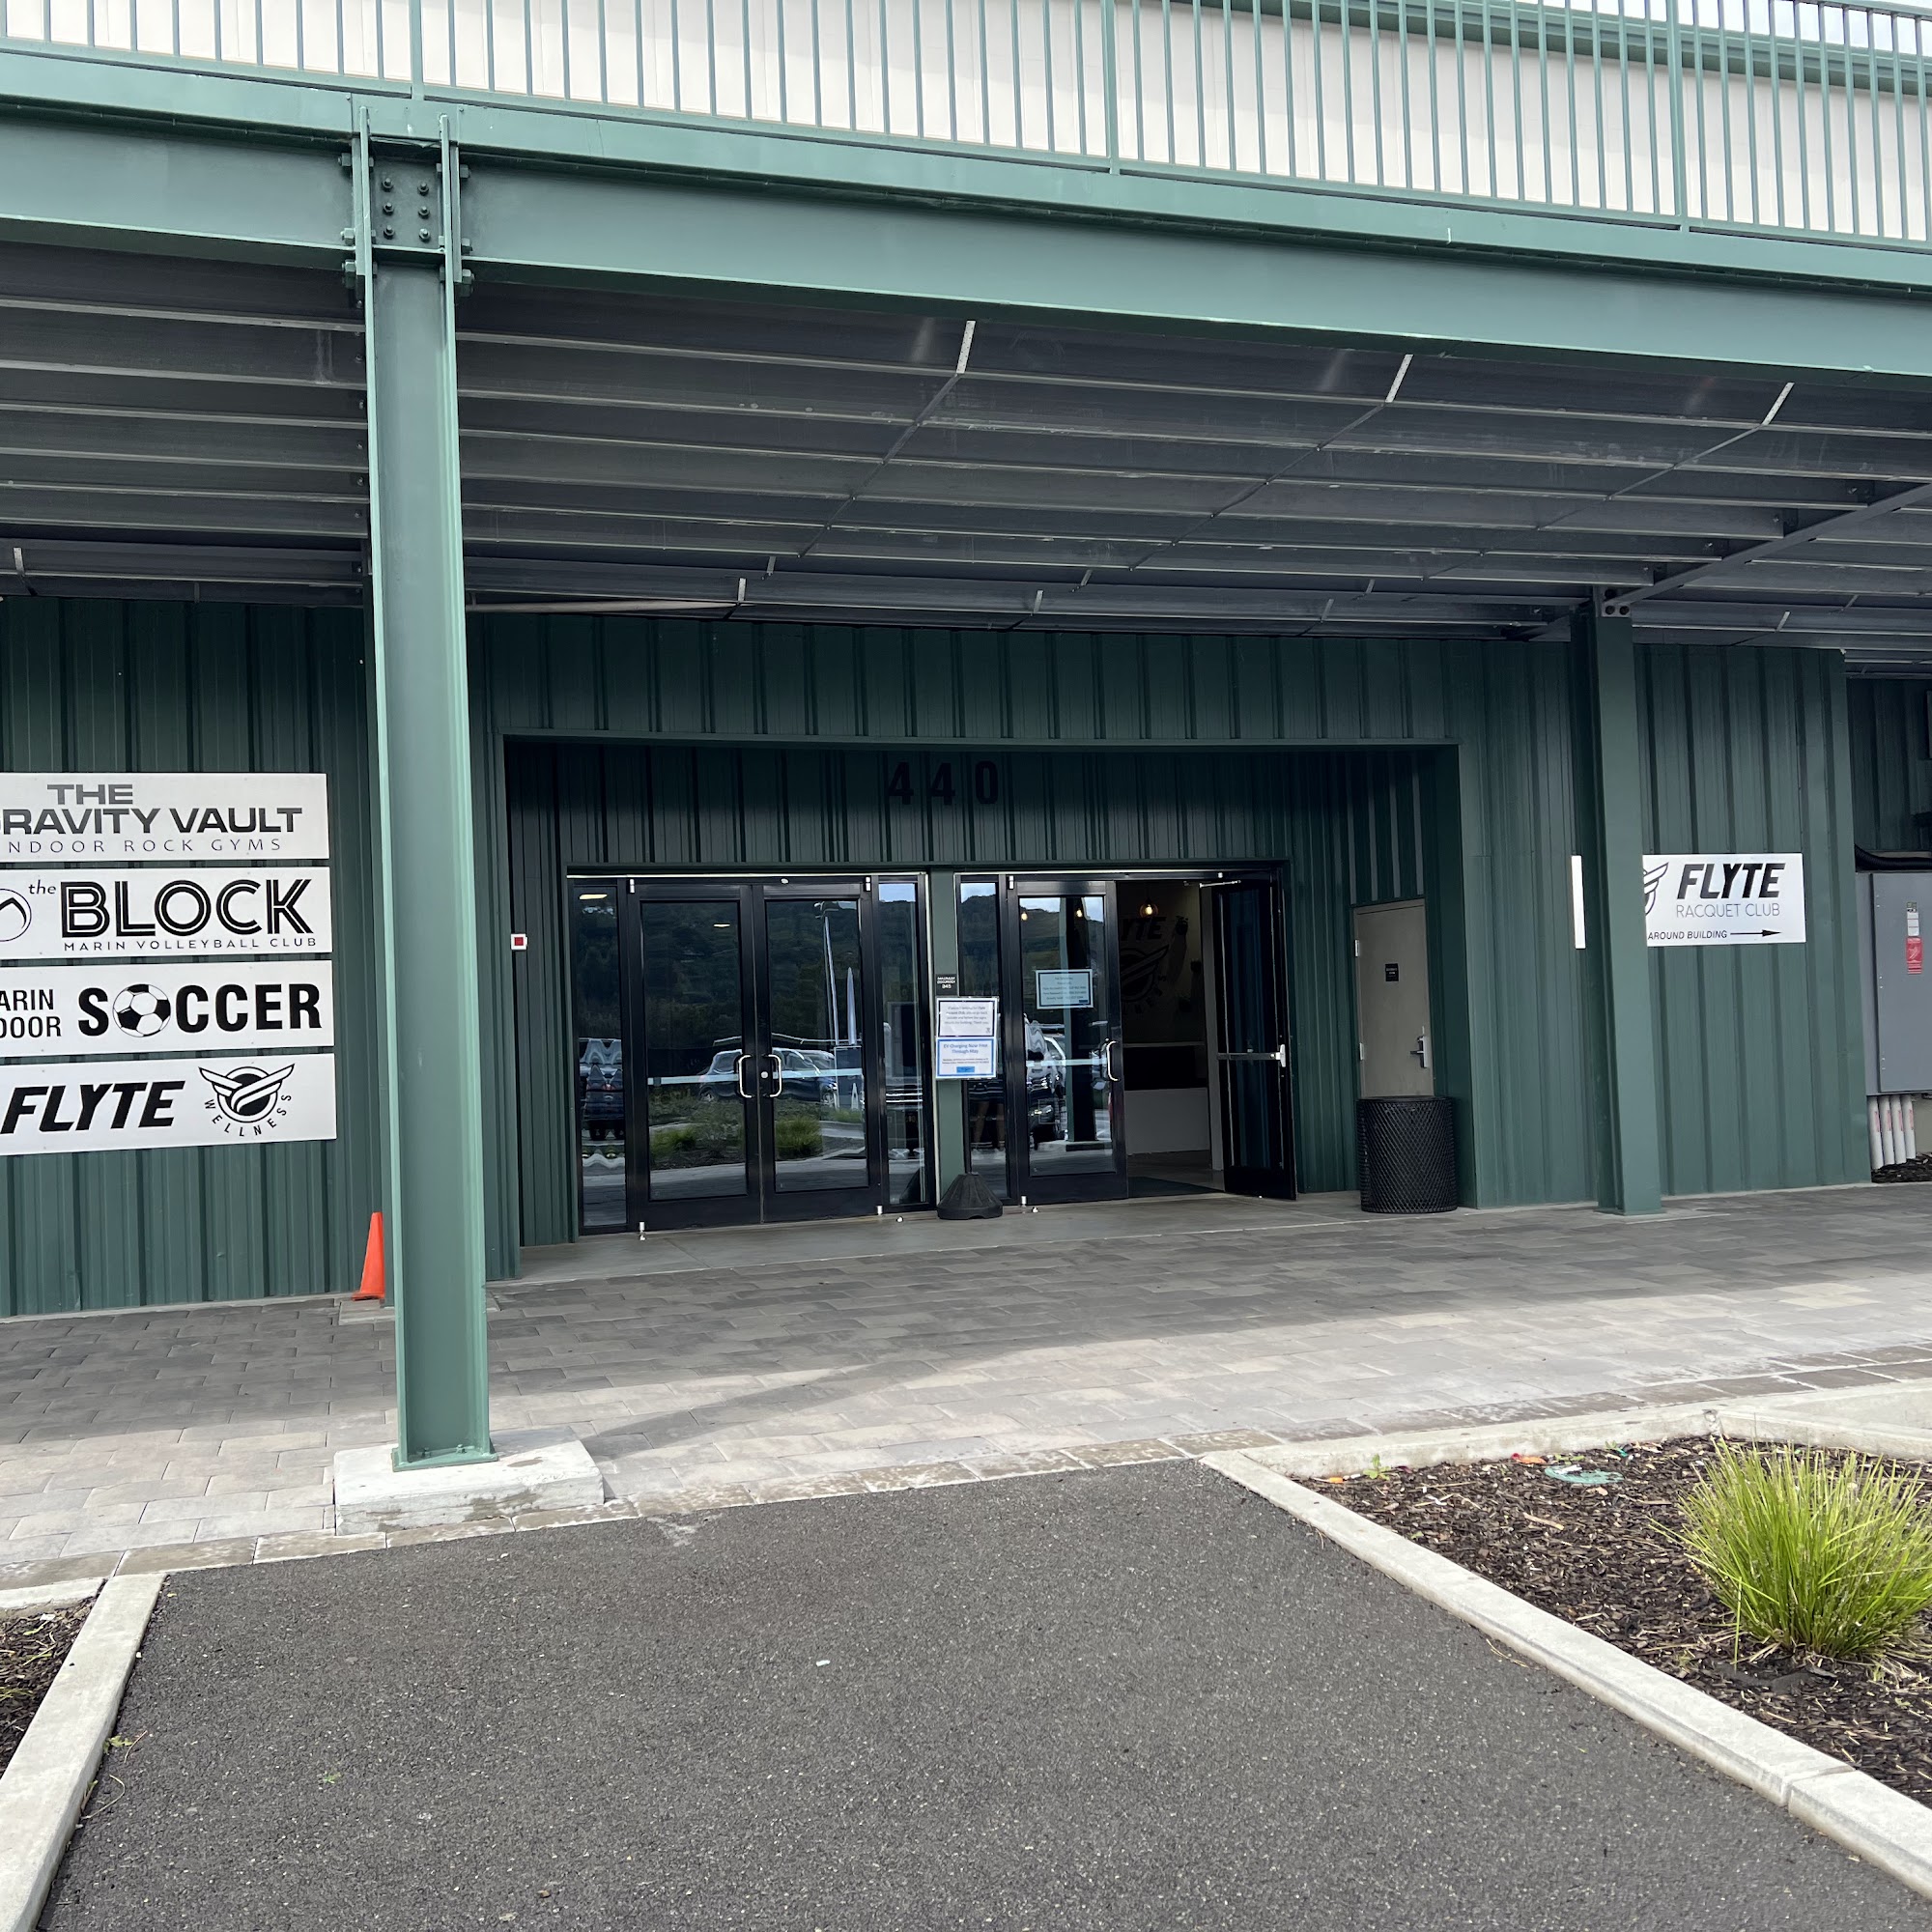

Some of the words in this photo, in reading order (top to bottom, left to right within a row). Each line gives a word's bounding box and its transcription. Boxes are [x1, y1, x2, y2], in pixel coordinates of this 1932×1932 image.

[46, 783, 134, 806] THE
[888, 760, 999, 806] 440
[0, 808, 161, 836] RAVITY
[169, 807, 303, 834] VAULT
[8, 839, 105, 854] NDOOR
[124, 838, 194, 852] ROCK
[211, 838, 281, 852] GYMS
[1676, 863, 1786, 900] FLYTE
[28, 879, 57, 895] the
[60, 878, 314, 939] BLOCK
[1676, 903, 1742, 918] RACQUET
[1745, 902, 1780, 917] CLUB
[64, 941, 127, 952] MARIN
[136, 938, 260, 950] VOLLEYBALL
[270, 937, 317, 948] CLUB
[1647, 931, 1685, 941] AROUND
[1687, 929, 1728, 940] BUILDING
[0, 988, 54, 1011] ARIN
[0, 1080, 186, 1135] FLYTE
[204, 1094, 293, 1138] WELLNESS
